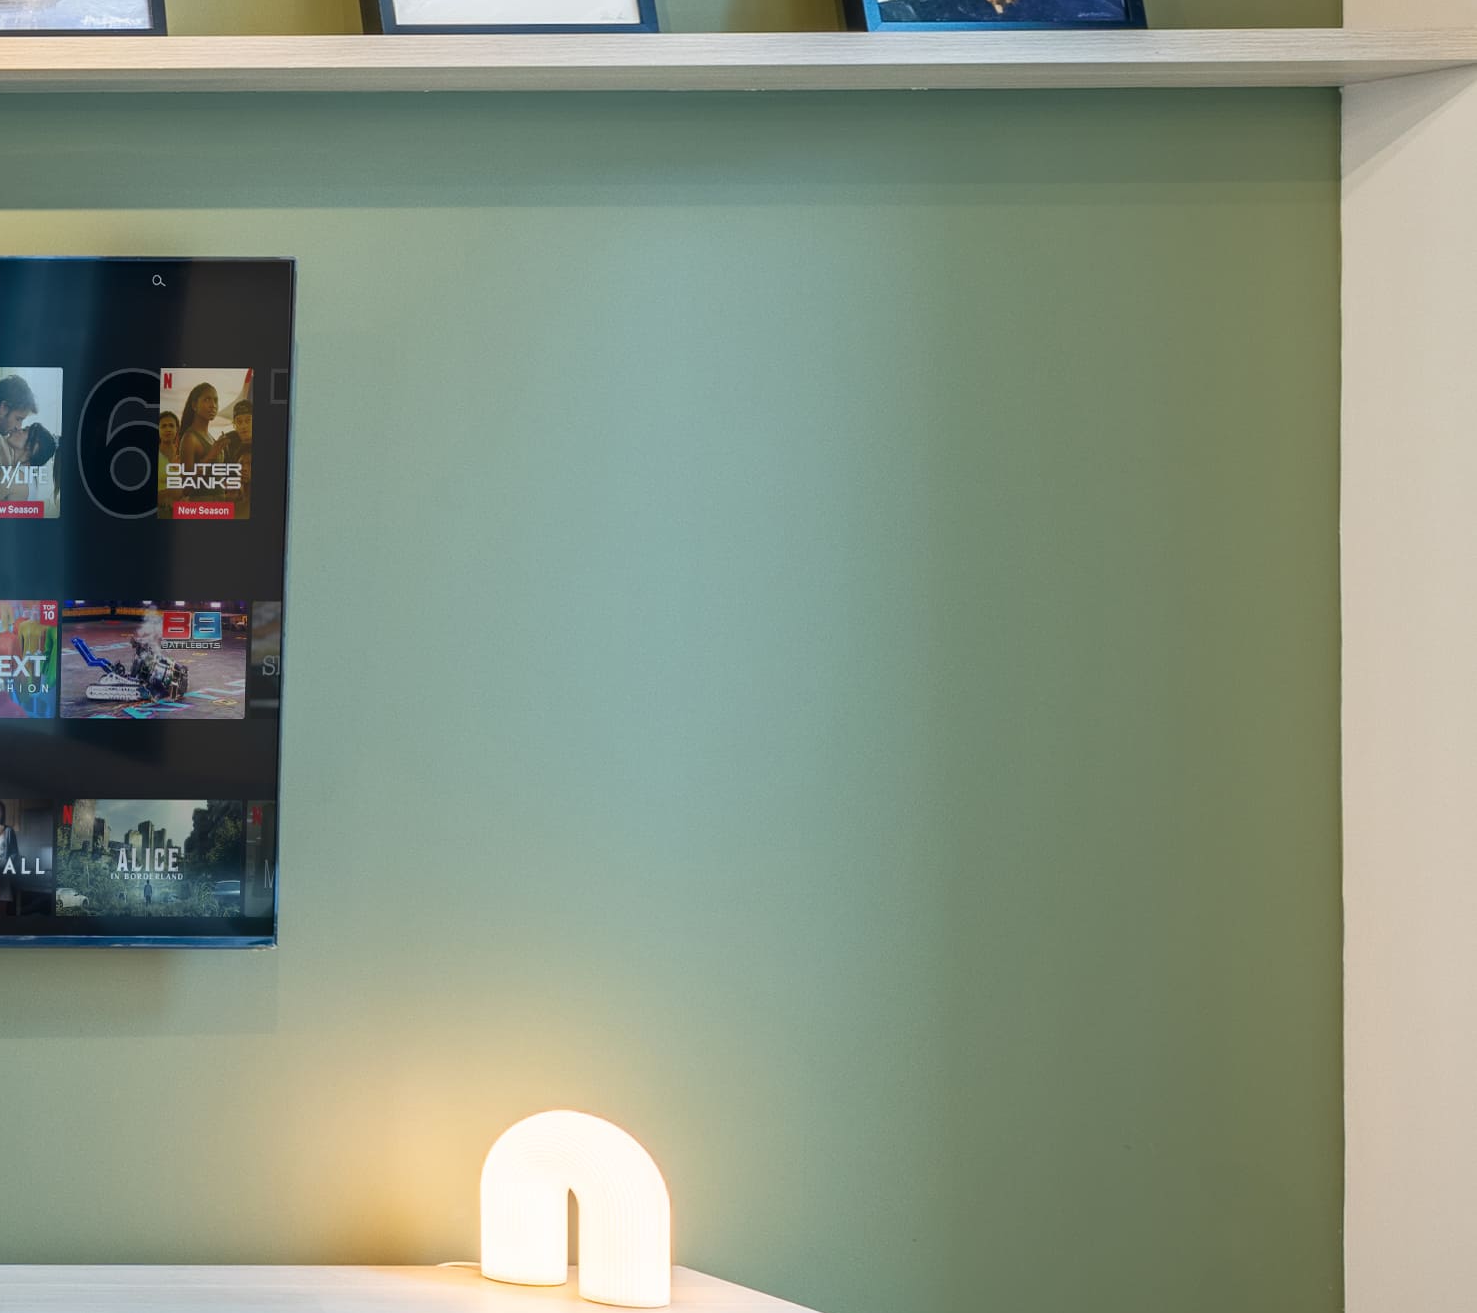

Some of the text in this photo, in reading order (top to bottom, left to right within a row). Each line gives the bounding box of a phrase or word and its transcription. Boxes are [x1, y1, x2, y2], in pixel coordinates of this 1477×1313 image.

[165, 463, 243, 476] OUTER
[165, 477, 242, 489] BANKS
[8, 505, 39, 514] Season
[178, 506, 229, 515] New Season
[43, 611, 55, 620] 10
[161, 641, 222, 650] BATTLEBOTS
[117, 847, 179, 872] ALICE
